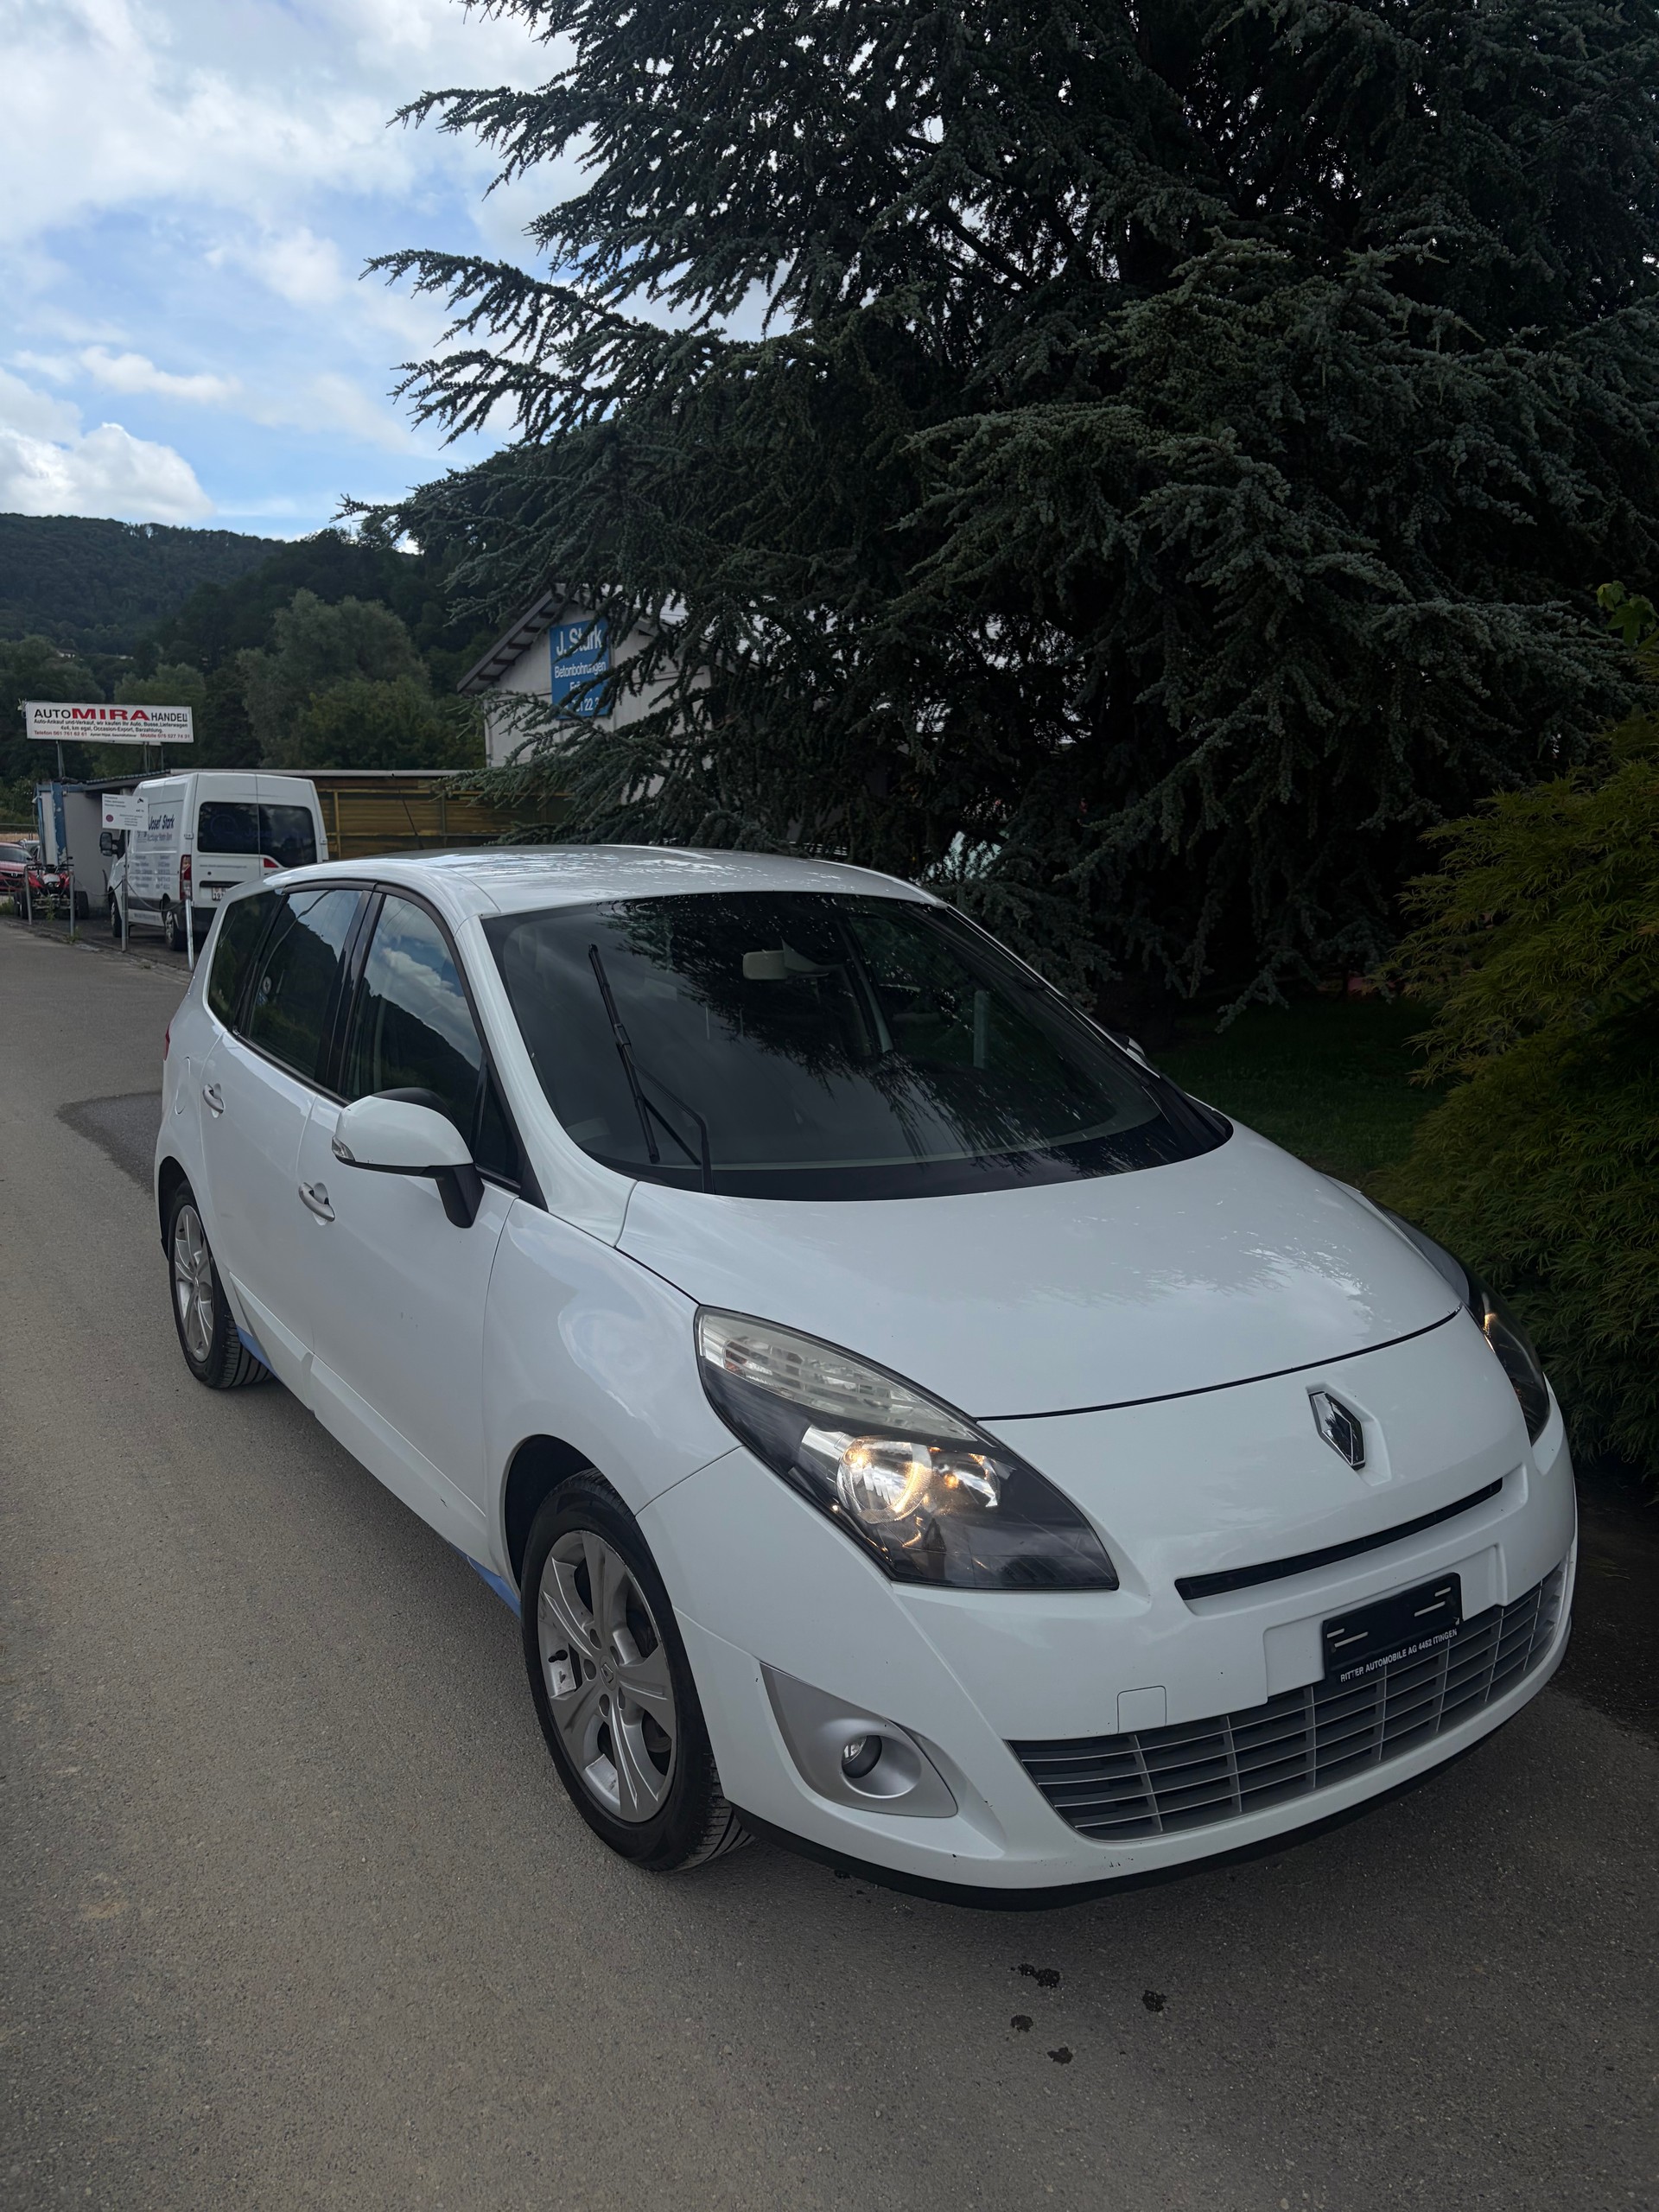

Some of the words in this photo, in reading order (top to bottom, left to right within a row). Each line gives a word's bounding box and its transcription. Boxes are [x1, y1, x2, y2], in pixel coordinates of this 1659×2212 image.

[556, 631, 567, 657] J.
[555, 662, 607, 678] Betonbohrungen
[34, 709, 71, 719] AUTO
[72, 708, 150, 721] MIRA
[151, 712, 188, 722] HANDEL
[162, 814, 175, 830] Stark
[1340, 1667, 1364, 1683] RITTER
[1365, 1649, 1407, 1673] AUTOMOBILE
[1408, 1644, 1417, 1656] AG
[1418, 1639, 1433, 1650] 4452
[1433, 1628, 1458, 1646] ITINGEN
